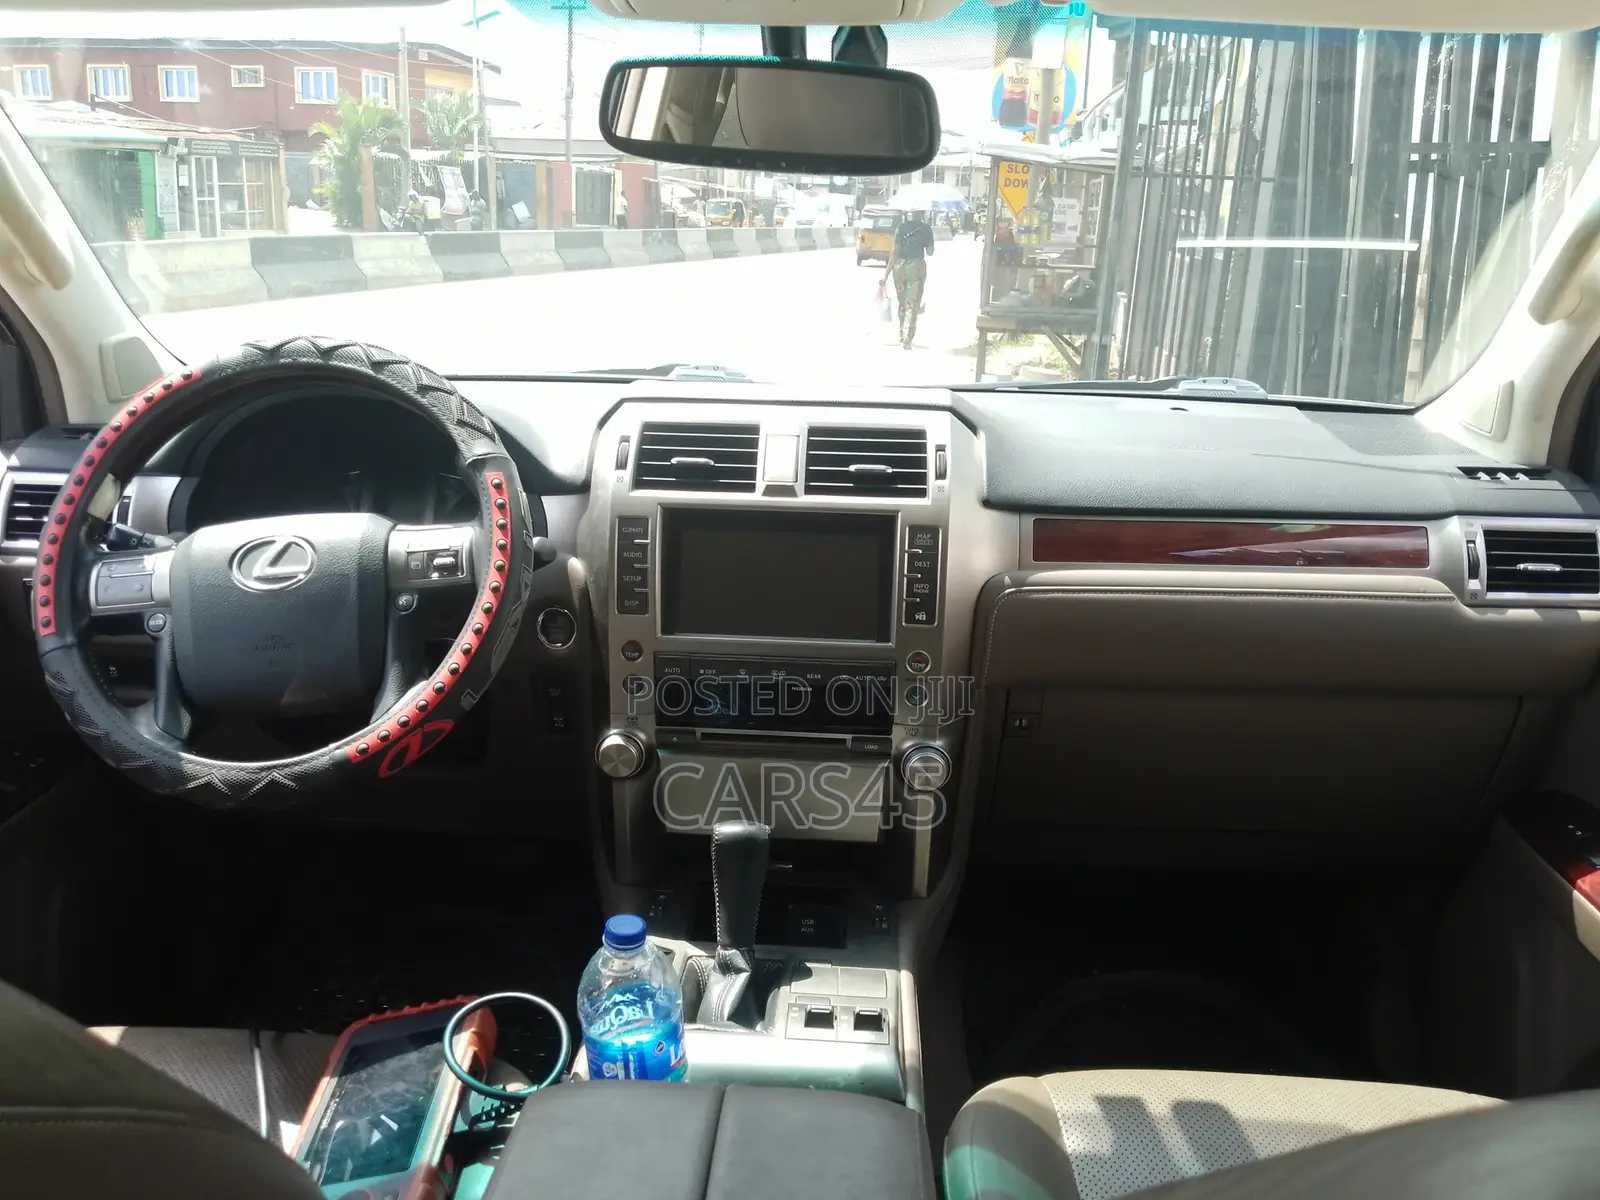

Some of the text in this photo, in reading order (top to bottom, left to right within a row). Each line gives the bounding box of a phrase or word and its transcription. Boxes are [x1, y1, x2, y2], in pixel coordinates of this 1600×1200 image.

[1006, 163, 1031, 174] SLO
[914, 560, 931, 568] DEST
[622, 575, 643, 583] SETUP
